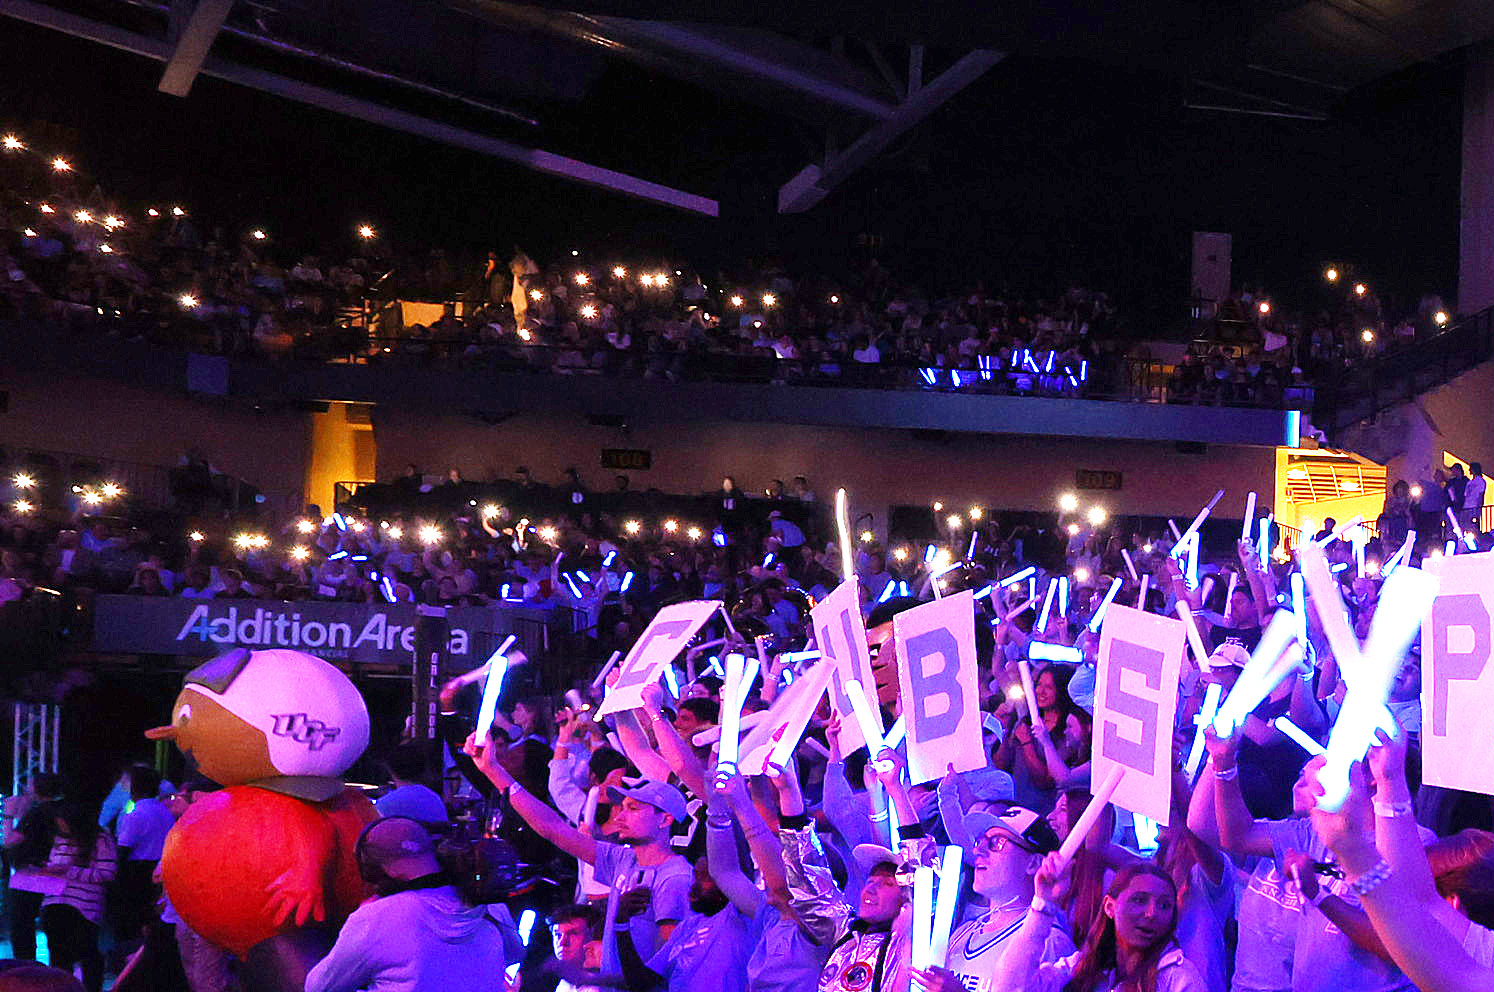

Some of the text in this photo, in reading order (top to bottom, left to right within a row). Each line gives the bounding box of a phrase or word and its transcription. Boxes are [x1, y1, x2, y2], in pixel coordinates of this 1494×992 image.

[176, 604, 469, 655] Addition Area
[614, 619, 694, 689] C
[1432, 594, 1491, 737] P
[270, 712, 342, 751] UCF
[905, 626, 964, 744] B
[1102, 638, 1164, 776] S
